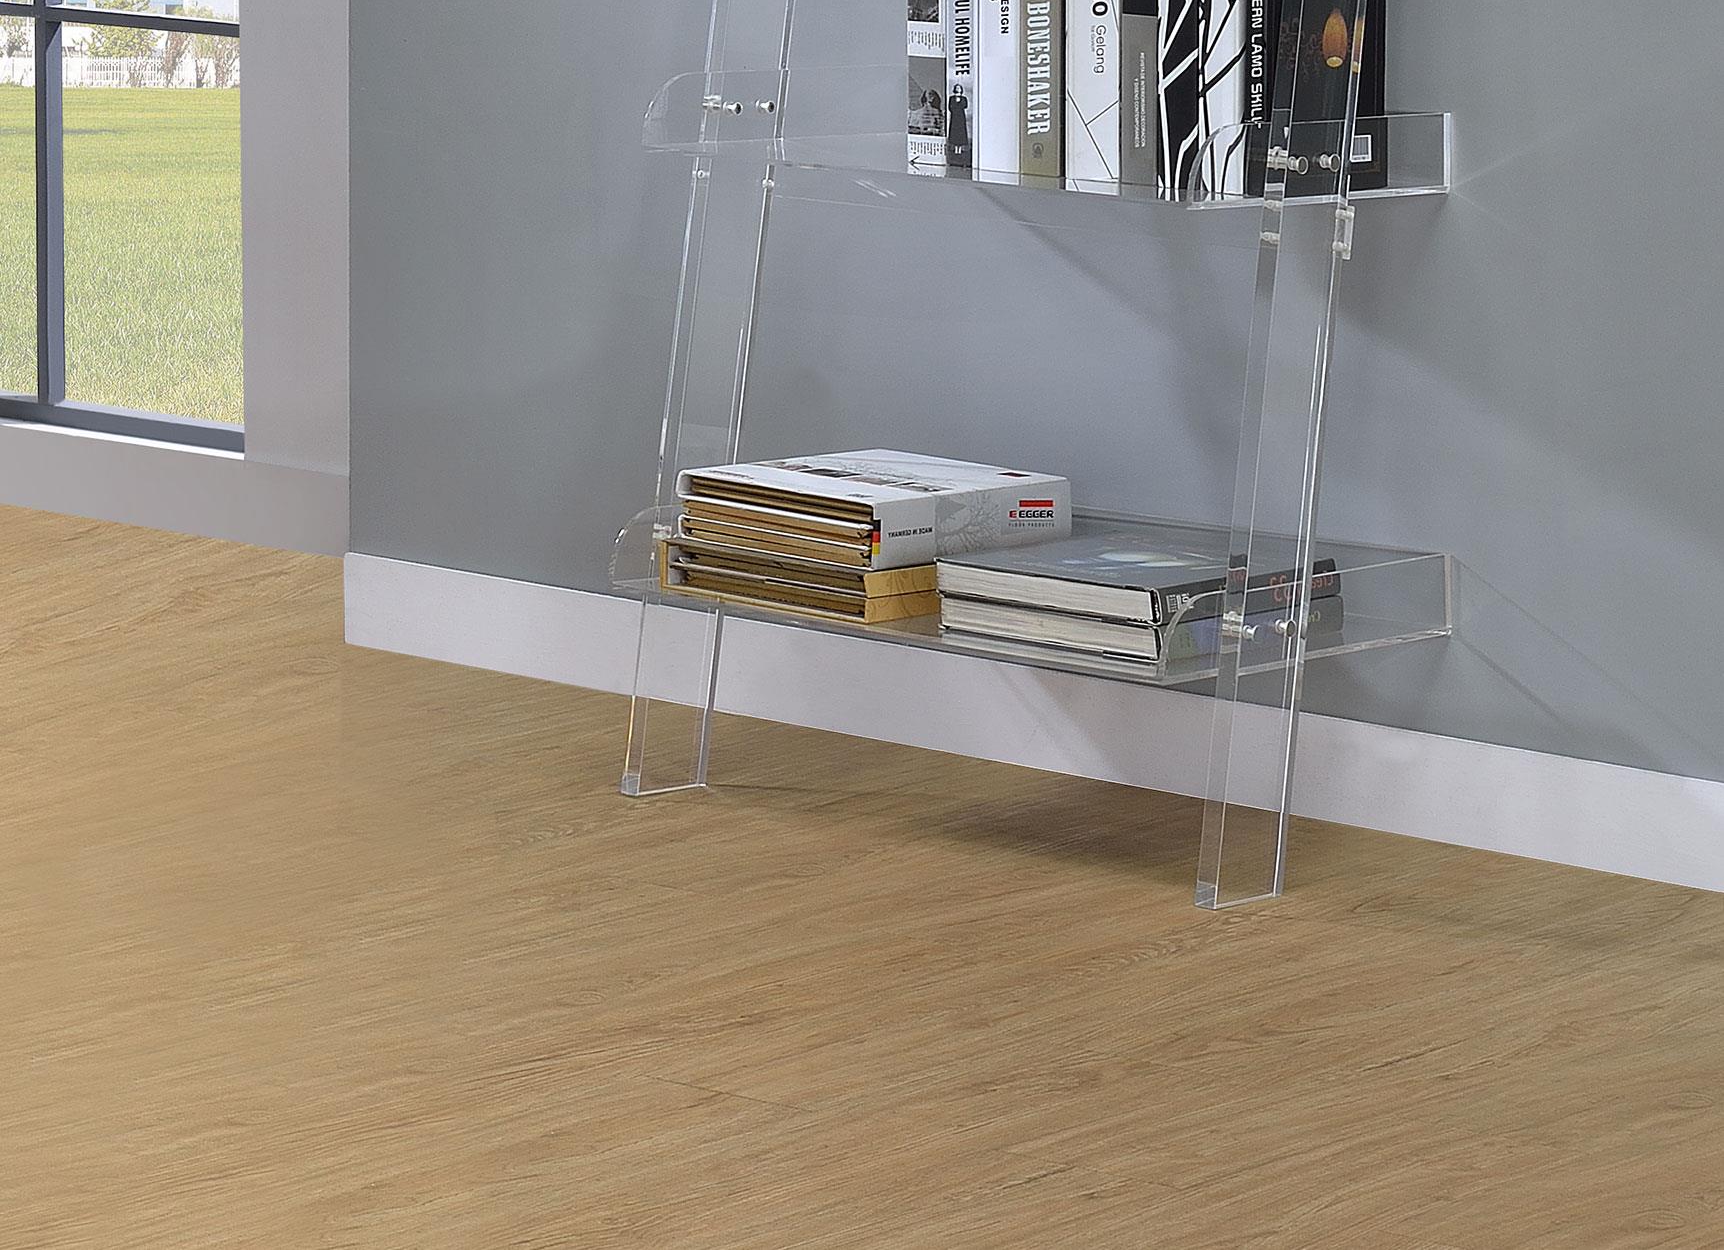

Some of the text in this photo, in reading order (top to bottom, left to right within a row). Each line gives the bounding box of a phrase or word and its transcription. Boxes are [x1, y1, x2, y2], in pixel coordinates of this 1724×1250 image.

[955, 17, 971, 76] HOMELIFE
[1027, 2, 1051, 135] BONESHAKER
[1093, 24, 1107, 74] Gelang
[1009, 510, 1054, 518] E EGGER
